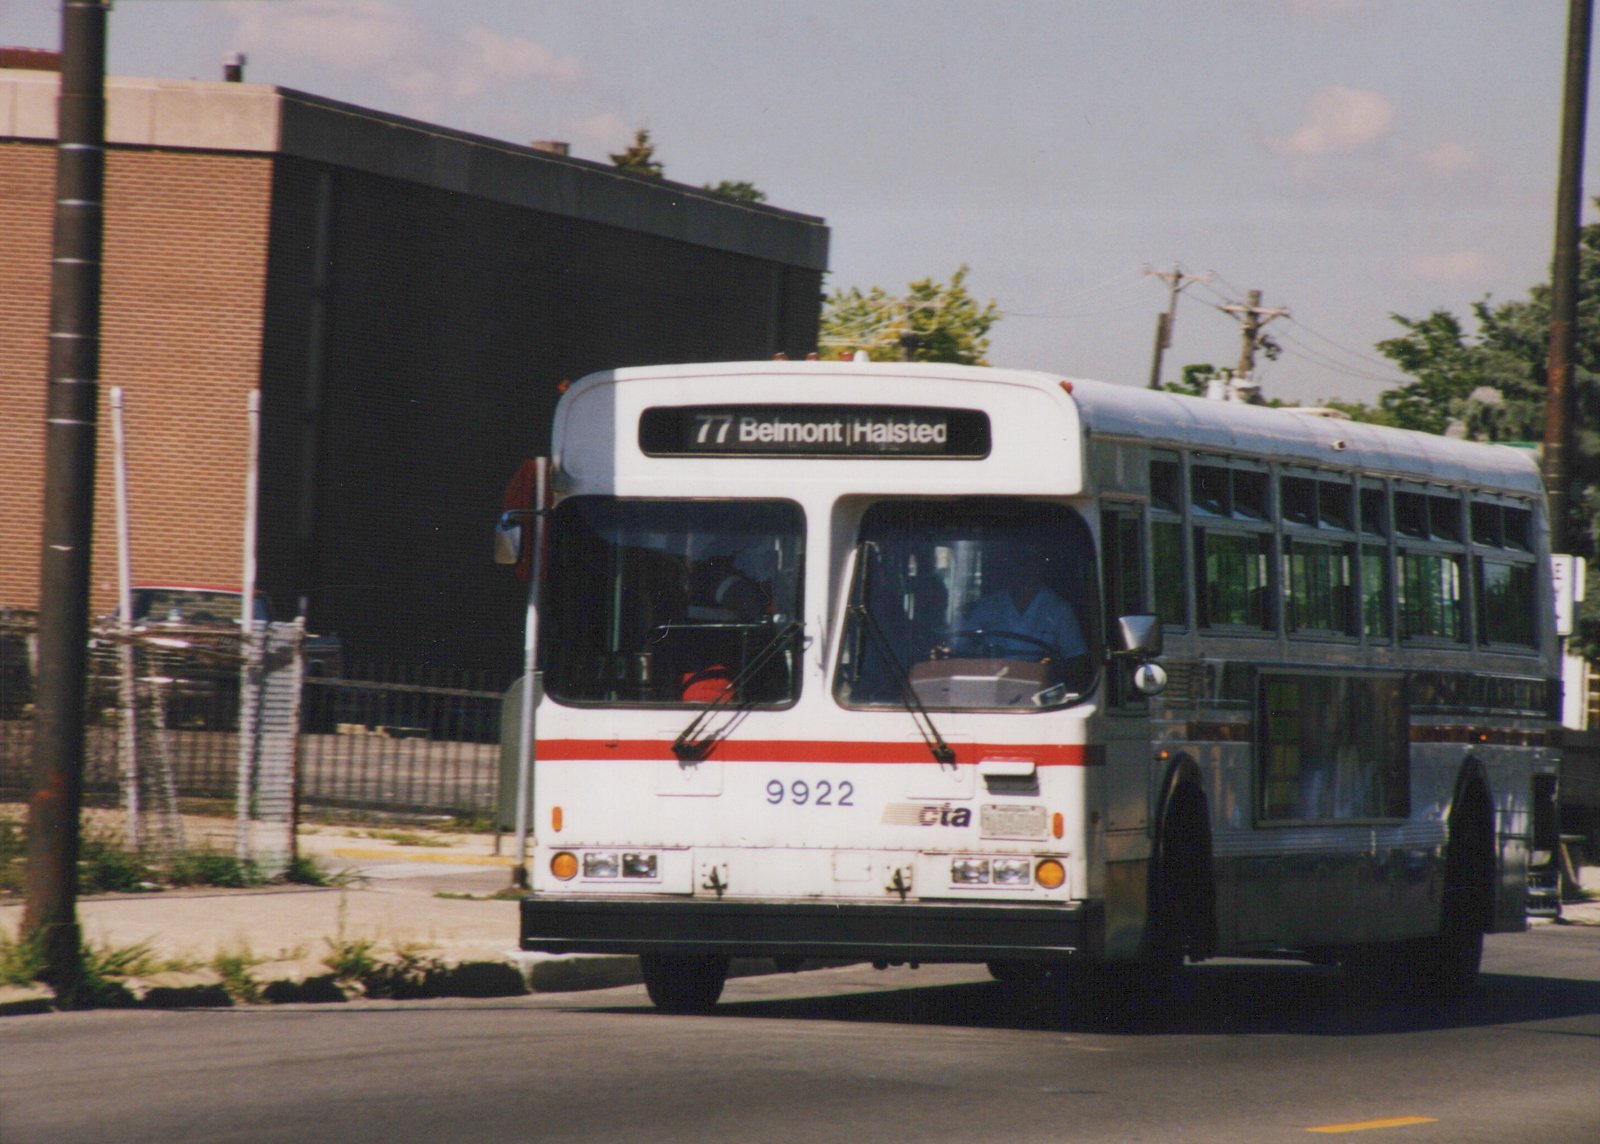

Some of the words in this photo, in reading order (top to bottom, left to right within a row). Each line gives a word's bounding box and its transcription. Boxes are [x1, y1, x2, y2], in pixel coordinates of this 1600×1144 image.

[695, 414, 732, 443] 77
[739, 417, 843, 442] Belmont
[853, 418, 947, 443] Halsted
[766, 779, 854, 806] 9922
[919, 802, 972, 828] cta
